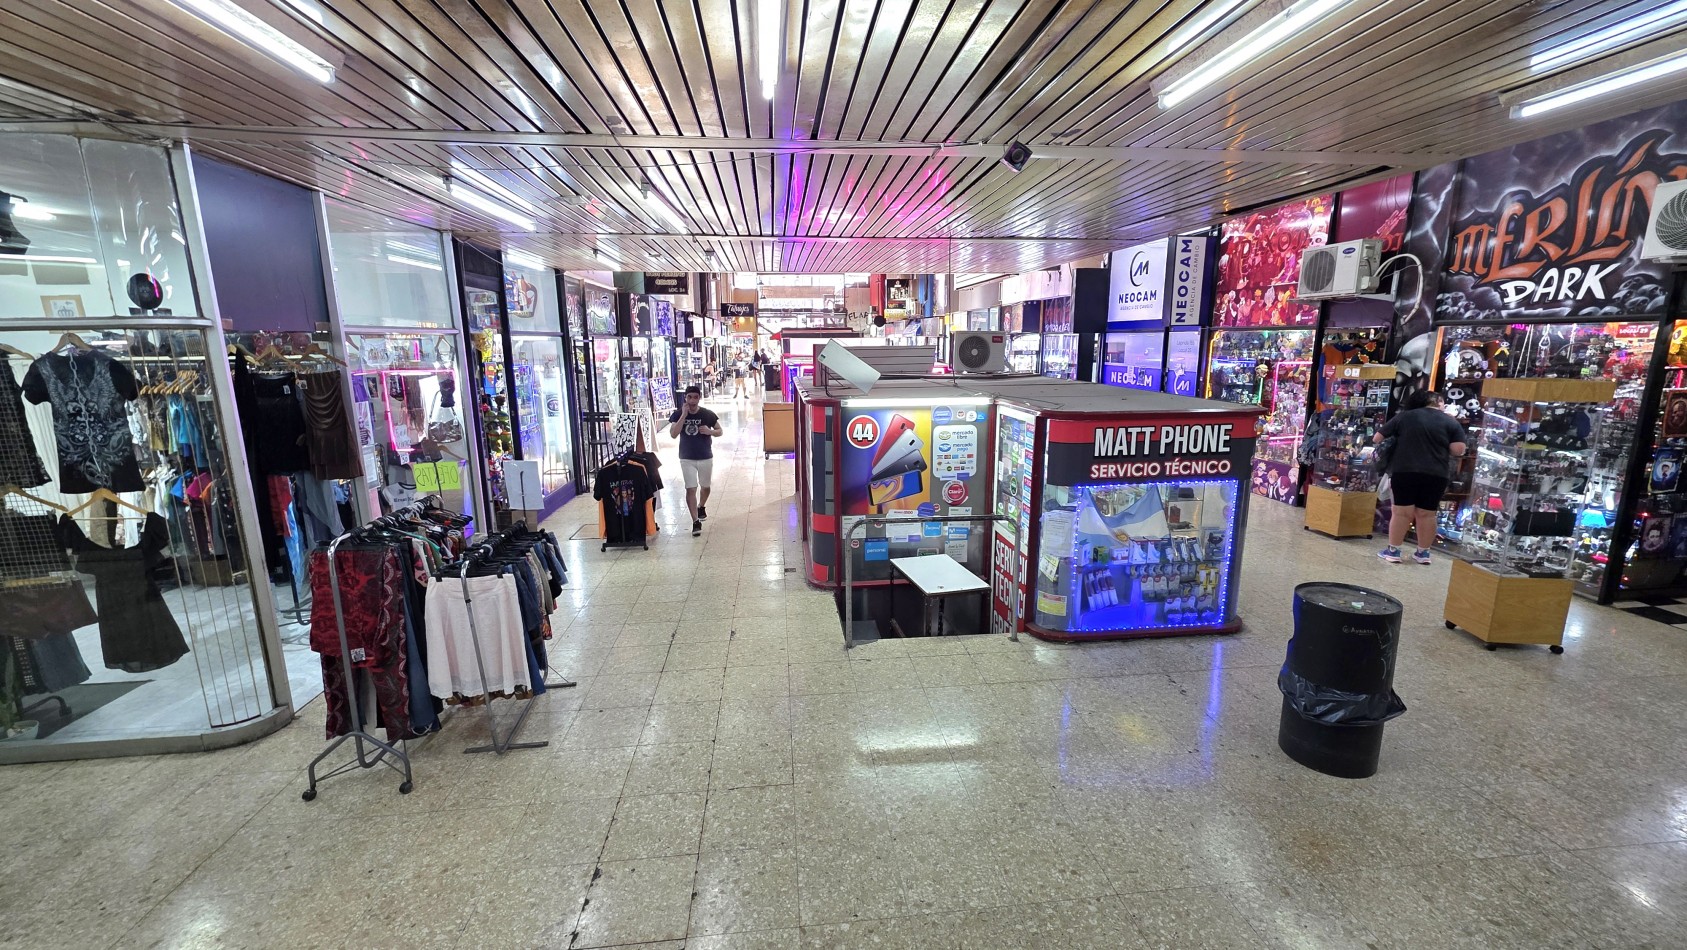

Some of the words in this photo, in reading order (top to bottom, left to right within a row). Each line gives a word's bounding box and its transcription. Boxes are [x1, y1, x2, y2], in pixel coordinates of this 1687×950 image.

[1175, 239, 1193, 323] NEOCAM
[1191, 275, 1197, 285] DE
[1500, 262, 1620, 306] DARK
[1118, 289, 1158, 305] NEOCAM
[1619, 327, 1639, 335] LOCAL
[1111, 371, 1153, 387] NEOCM
[852, 422, 874, 441] 44
[1094, 426, 1155, 457] MATT
[1159, 424, 1233, 454] PHONE
[1090, 461, 1161, 478] SERVICIO
[1164, 457, 1231, 476] TÉCNICO
